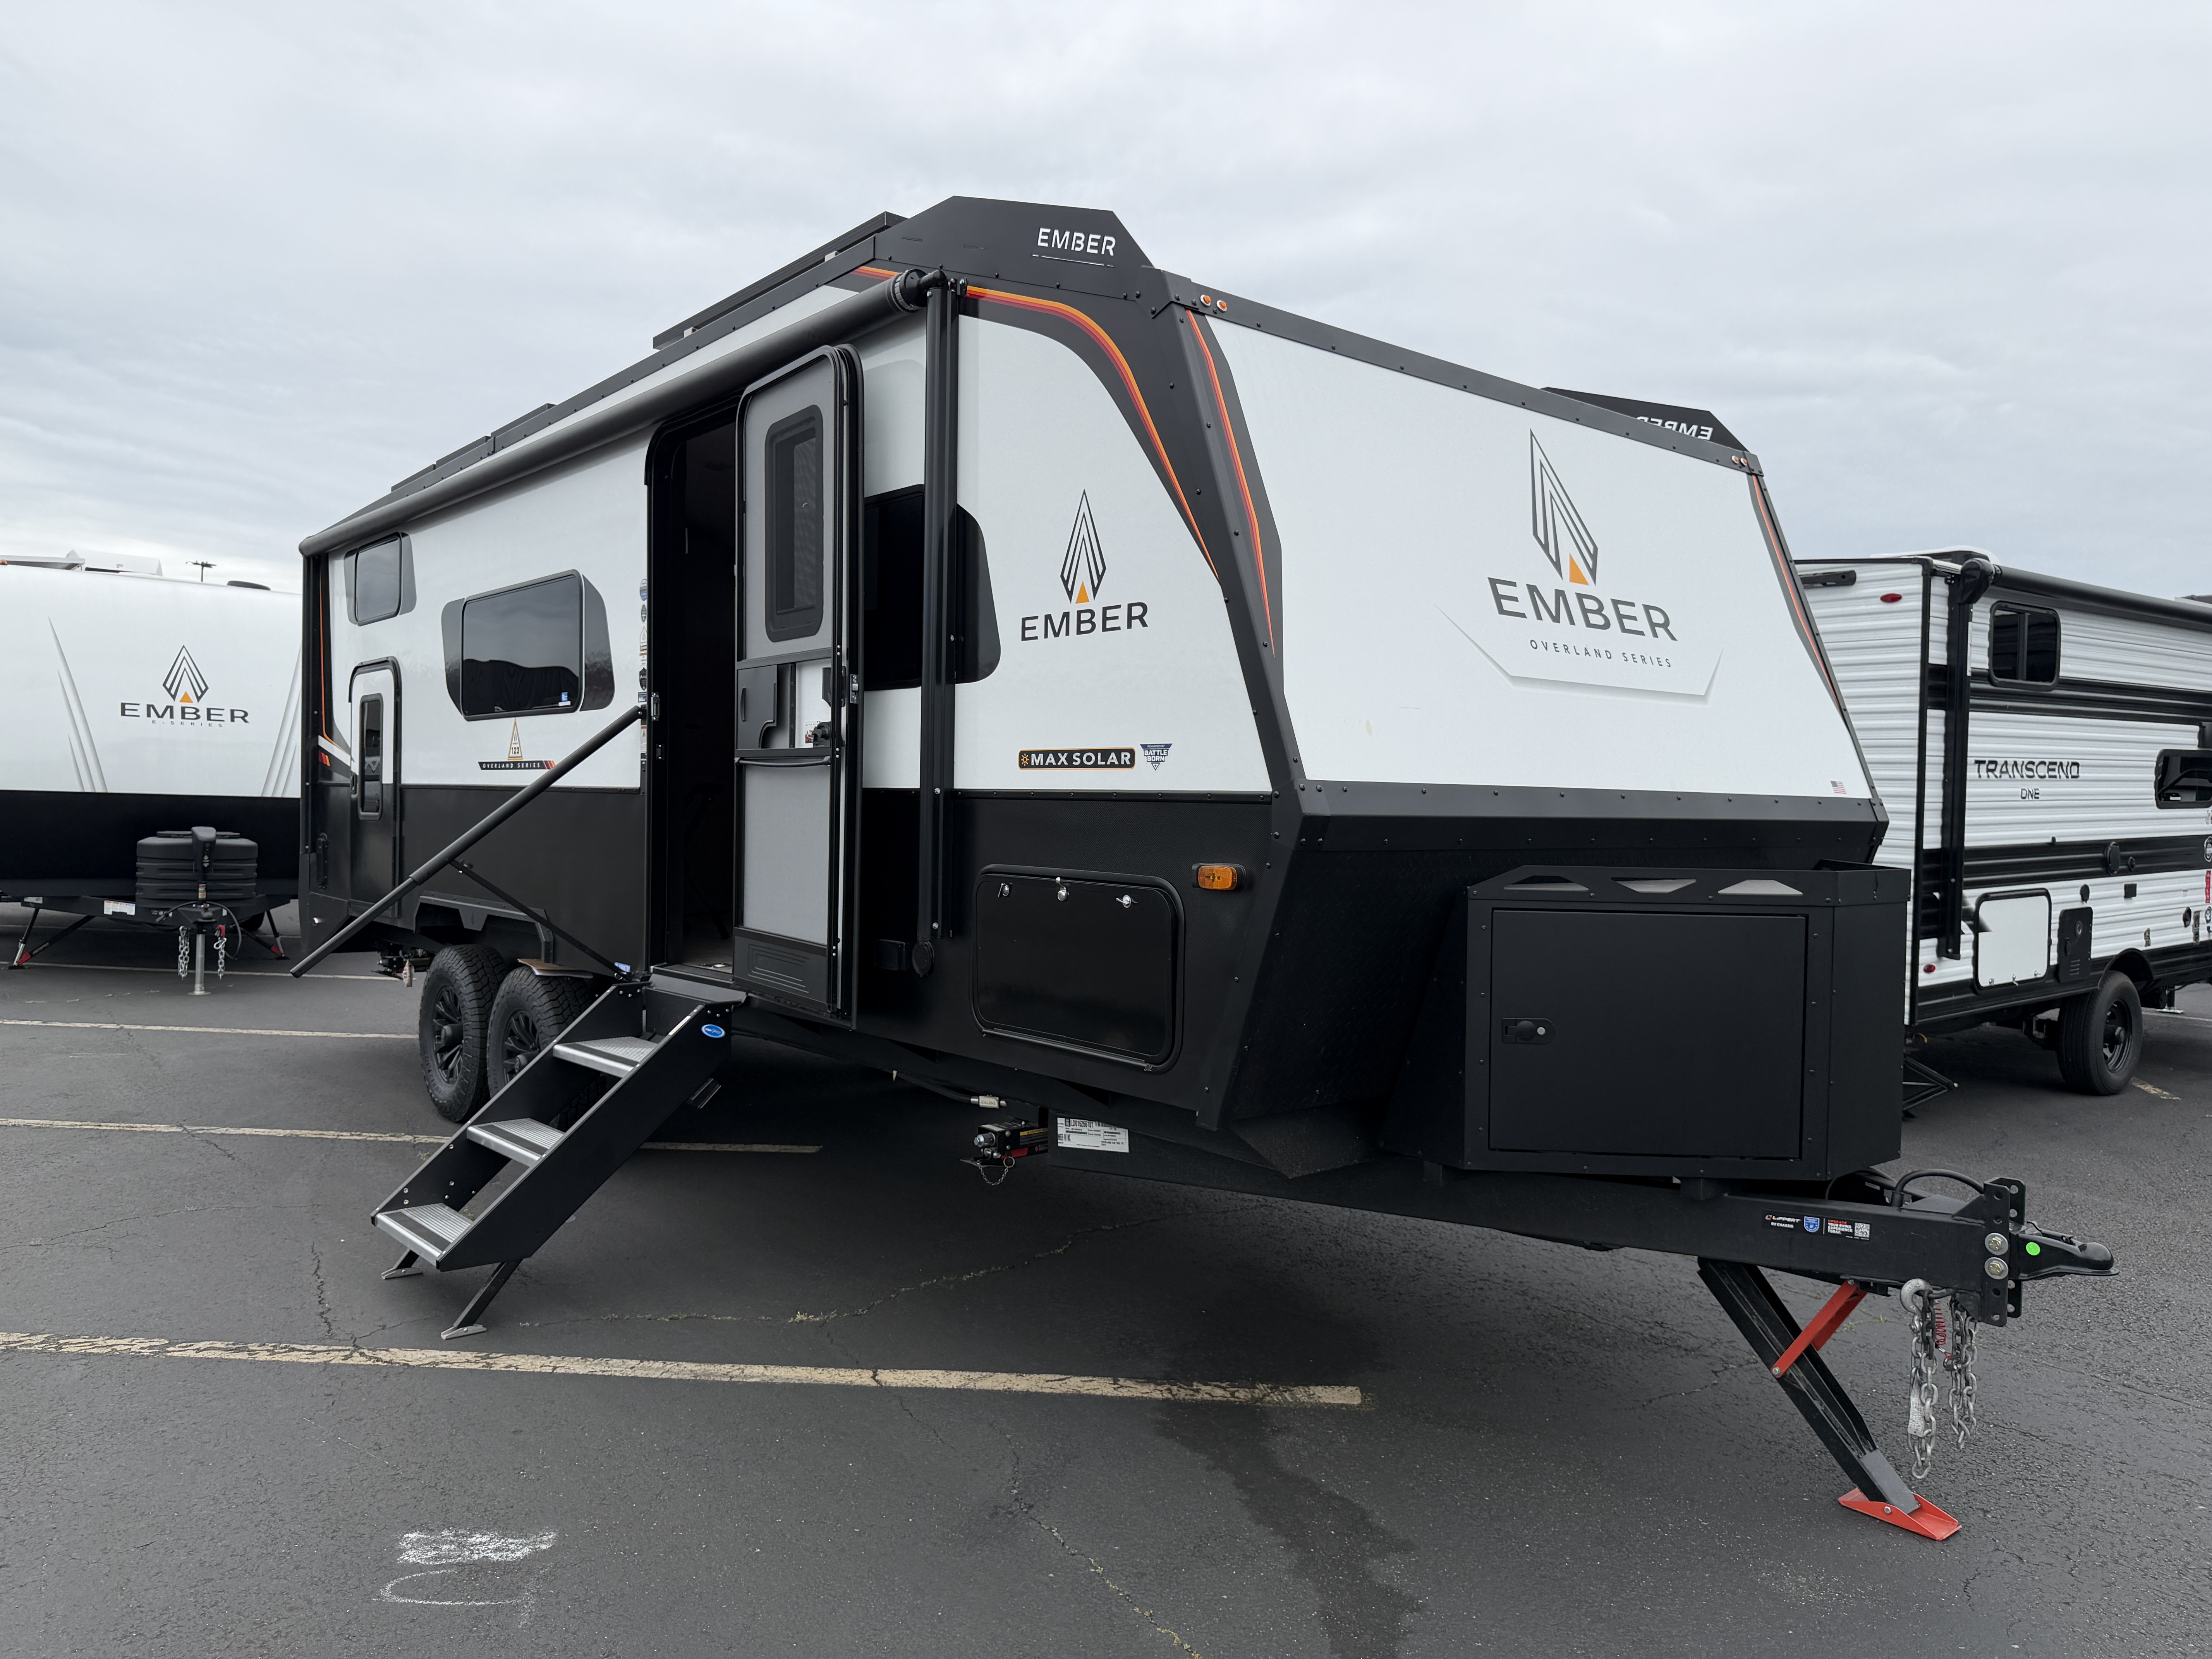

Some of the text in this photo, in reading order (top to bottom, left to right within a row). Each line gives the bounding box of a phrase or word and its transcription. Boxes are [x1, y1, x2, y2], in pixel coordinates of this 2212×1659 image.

[1038, 227, 1116, 256] EMBER
[1021, 602, 1148, 641] EMBER
[1487, 577, 1678, 641] EMBER
[1530, 639, 1671, 668] OVERLAND SERIES
[120, 702, 250, 723] EMBER
[1031, 752, 1131, 766] MAX SOLAR
[1974, 760, 2080, 779] TRANSCEND
[2020, 788, 2040, 799] ONE
